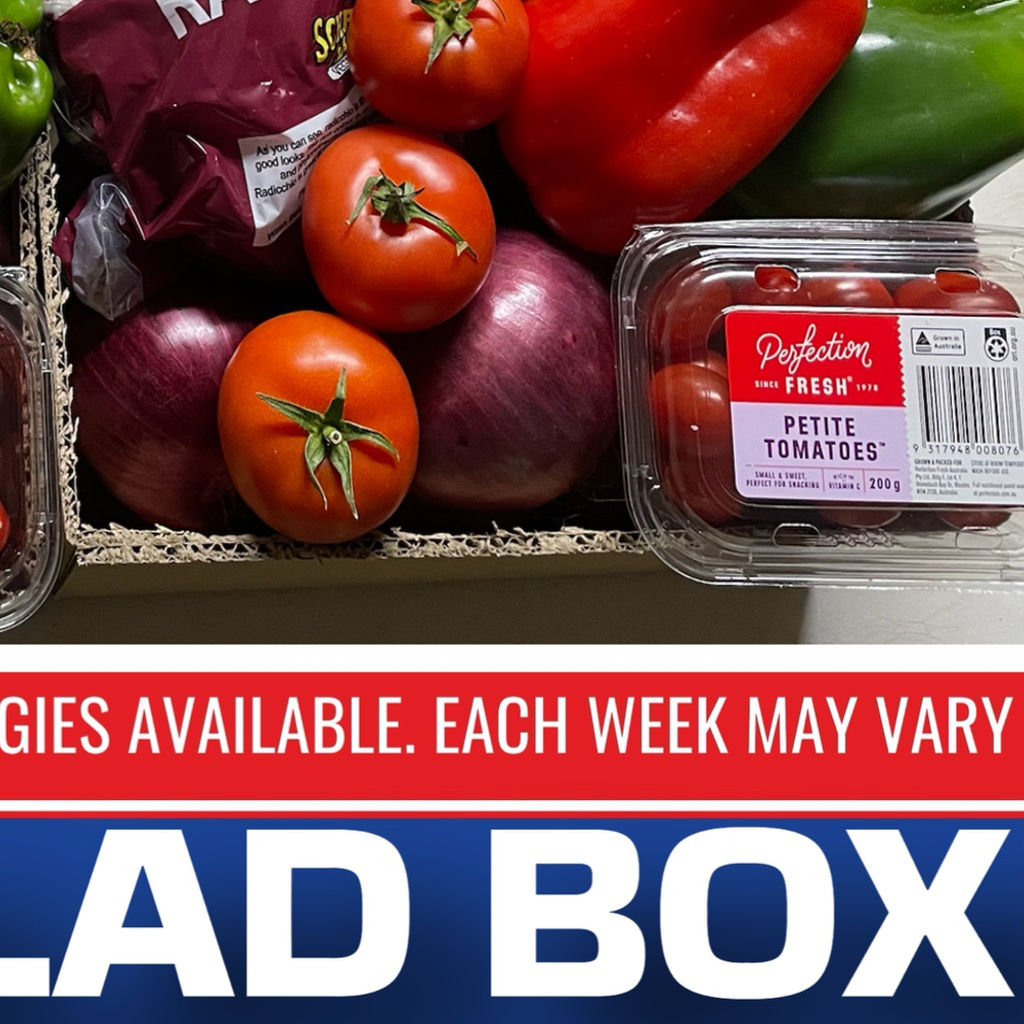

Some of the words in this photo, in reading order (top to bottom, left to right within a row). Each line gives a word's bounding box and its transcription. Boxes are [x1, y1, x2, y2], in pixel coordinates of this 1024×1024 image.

[255, 144, 269, 156] As
[272, 144, 288, 157] you
[290, 137, 306, 150] can
[255, 156, 279, 173] good
[756, 323, 873, 375] Perfection
[754, 380, 779, 388] SINCE
[783, 415, 856, 437] PETITE
[746, 479, 772, 487] PERFECT
[774, 479, 786, 488] FOR
[788, 480, 820, 489] SNACKING
